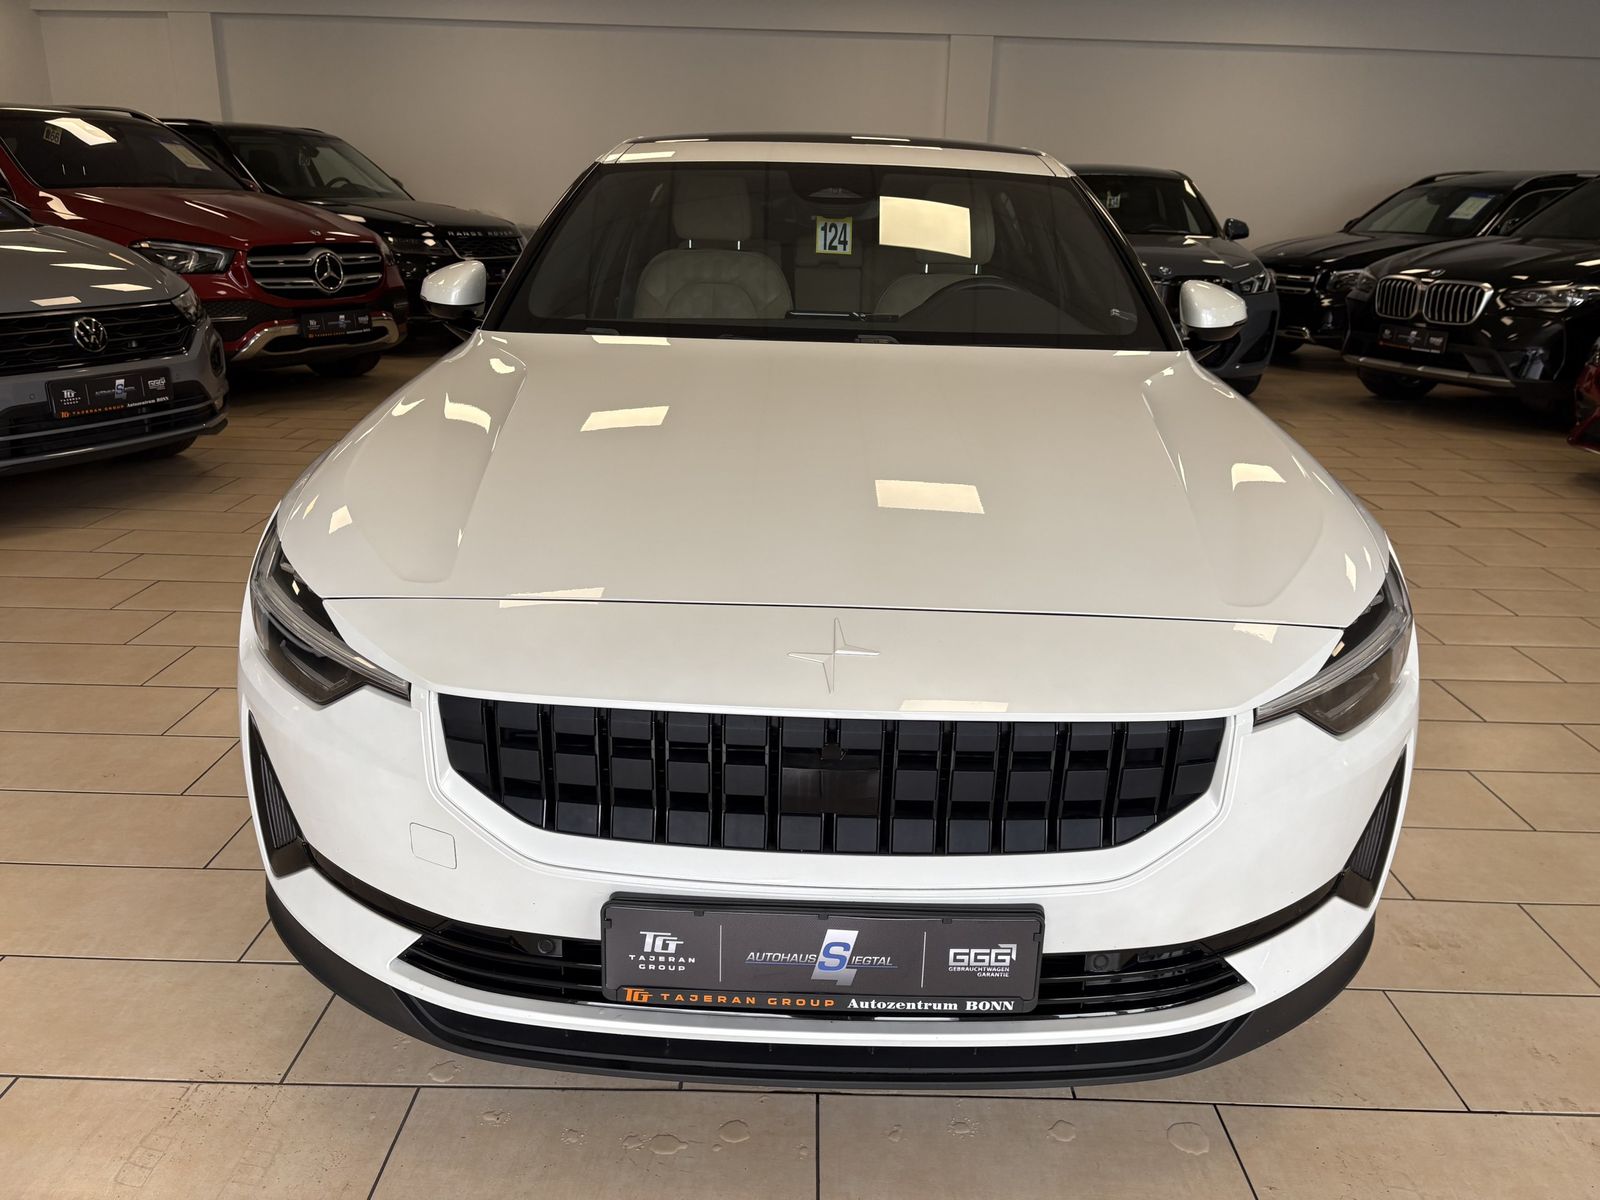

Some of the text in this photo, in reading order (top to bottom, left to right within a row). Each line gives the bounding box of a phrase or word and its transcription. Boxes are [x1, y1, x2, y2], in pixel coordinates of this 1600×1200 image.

[820, 221, 849, 251] 124
[628, 954, 696, 963] TAJERAN
[746, 951, 817, 964] AUTOHAUS
[948, 948, 1012, 967] GGG
[638, 963, 686, 971] GROUP
[660, 993, 756, 1005] TAJERAN
[767, 997, 836, 1008] GROUP
[846, 998, 959, 1011] Autozentrum
[964, 1000, 1016, 1011] BONN
